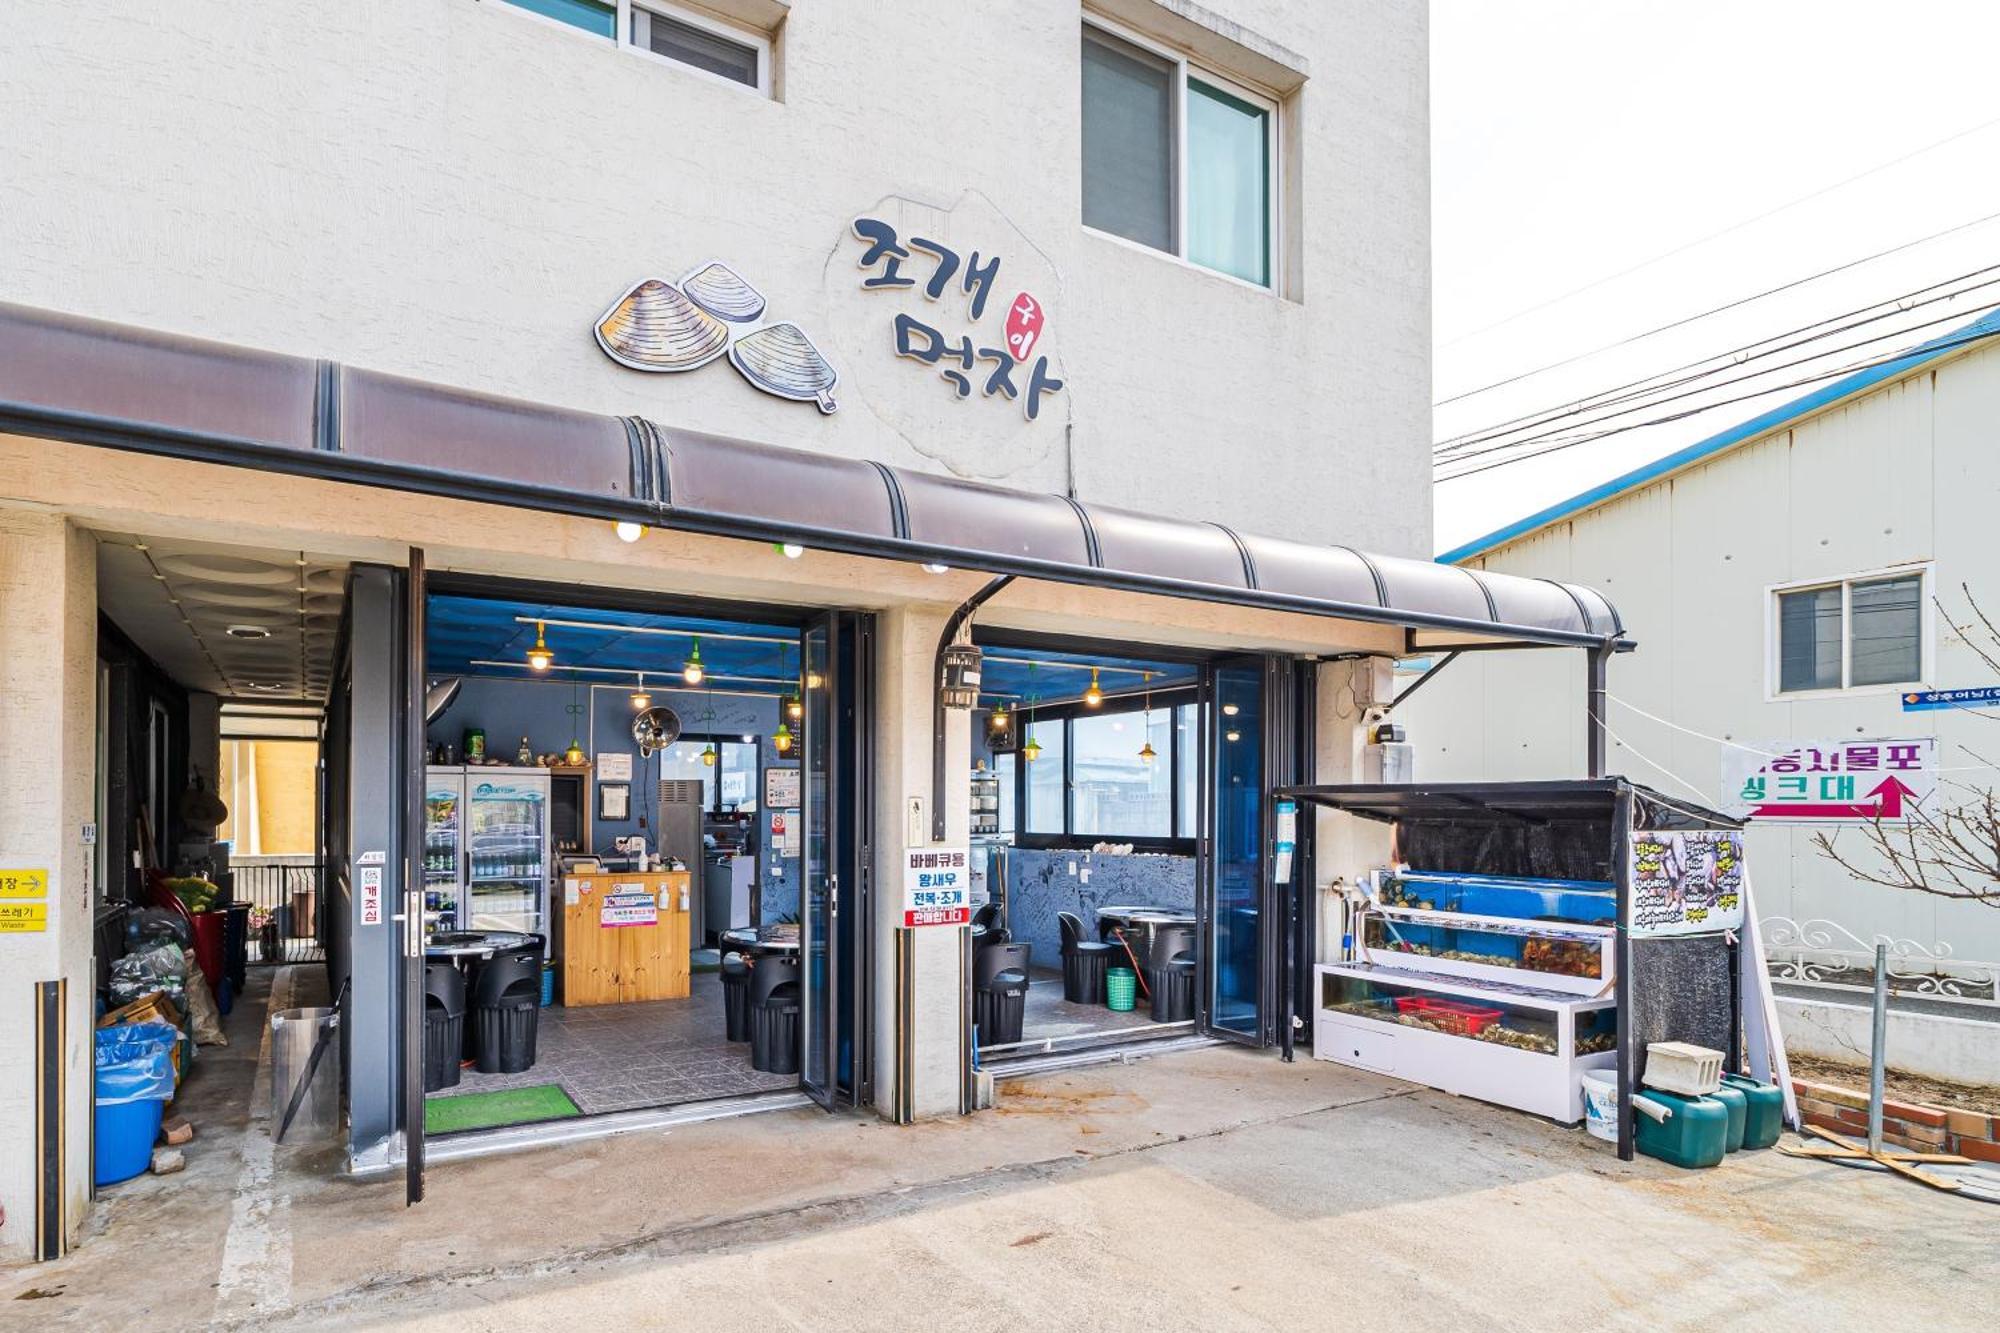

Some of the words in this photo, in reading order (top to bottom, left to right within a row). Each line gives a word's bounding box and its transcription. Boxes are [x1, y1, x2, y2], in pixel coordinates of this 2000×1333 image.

[852, 218, 1000, 321] 조개
[893, 312, 1063, 420] 먹자
[1740, 775, 1854, 801] 싱크대
[910, 853, 965, 868] 바베큐용
[0, 878, 17, 890] 장
[919, 873, 957, 888] 왕새우
[364, 886, 378, 922] 개조심
[913, 889, 963, 906] 전복·조개
[0, 908, 33, 918] 쓰레기
[913, 909, 963, 925] 판매합니다
